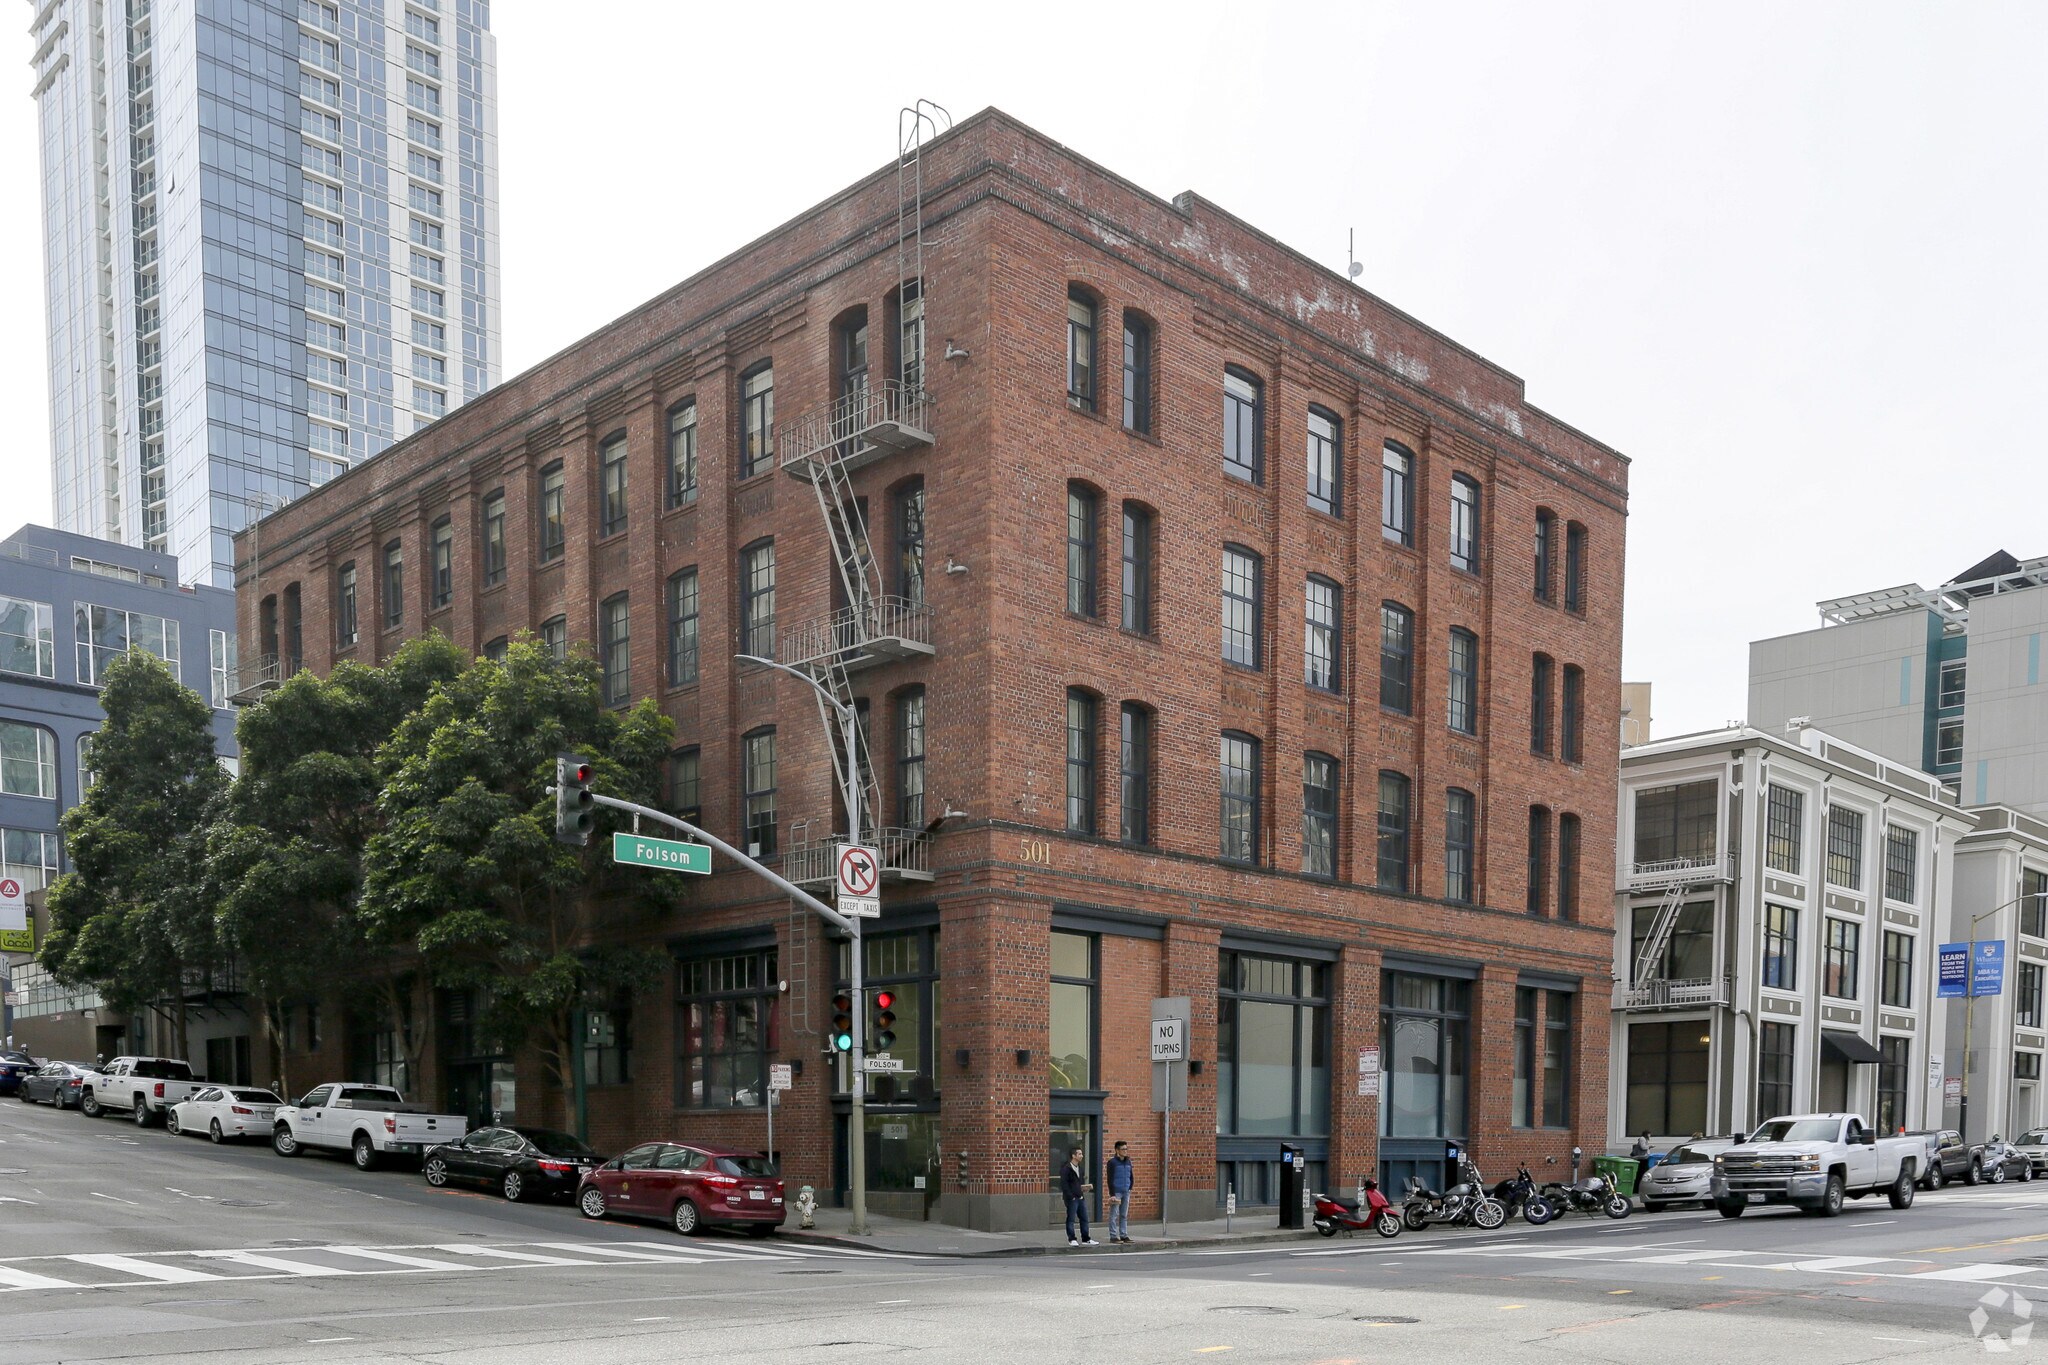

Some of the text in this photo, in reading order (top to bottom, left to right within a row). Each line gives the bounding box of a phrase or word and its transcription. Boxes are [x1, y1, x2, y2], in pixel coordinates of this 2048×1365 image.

[636, 843, 690, 864] Folsom
[1020, 838, 1051, 865] 501
[840, 901, 878, 912] EXCEPT TAXIS
[3, 938, 32, 949] Local
[1941, 954, 1966, 962] LEARN
[1160, 1025, 1174, 1038] NO
[1153, 1043, 1180, 1054] TURNS
[869, 1060, 897, 1068] FOLSOM
